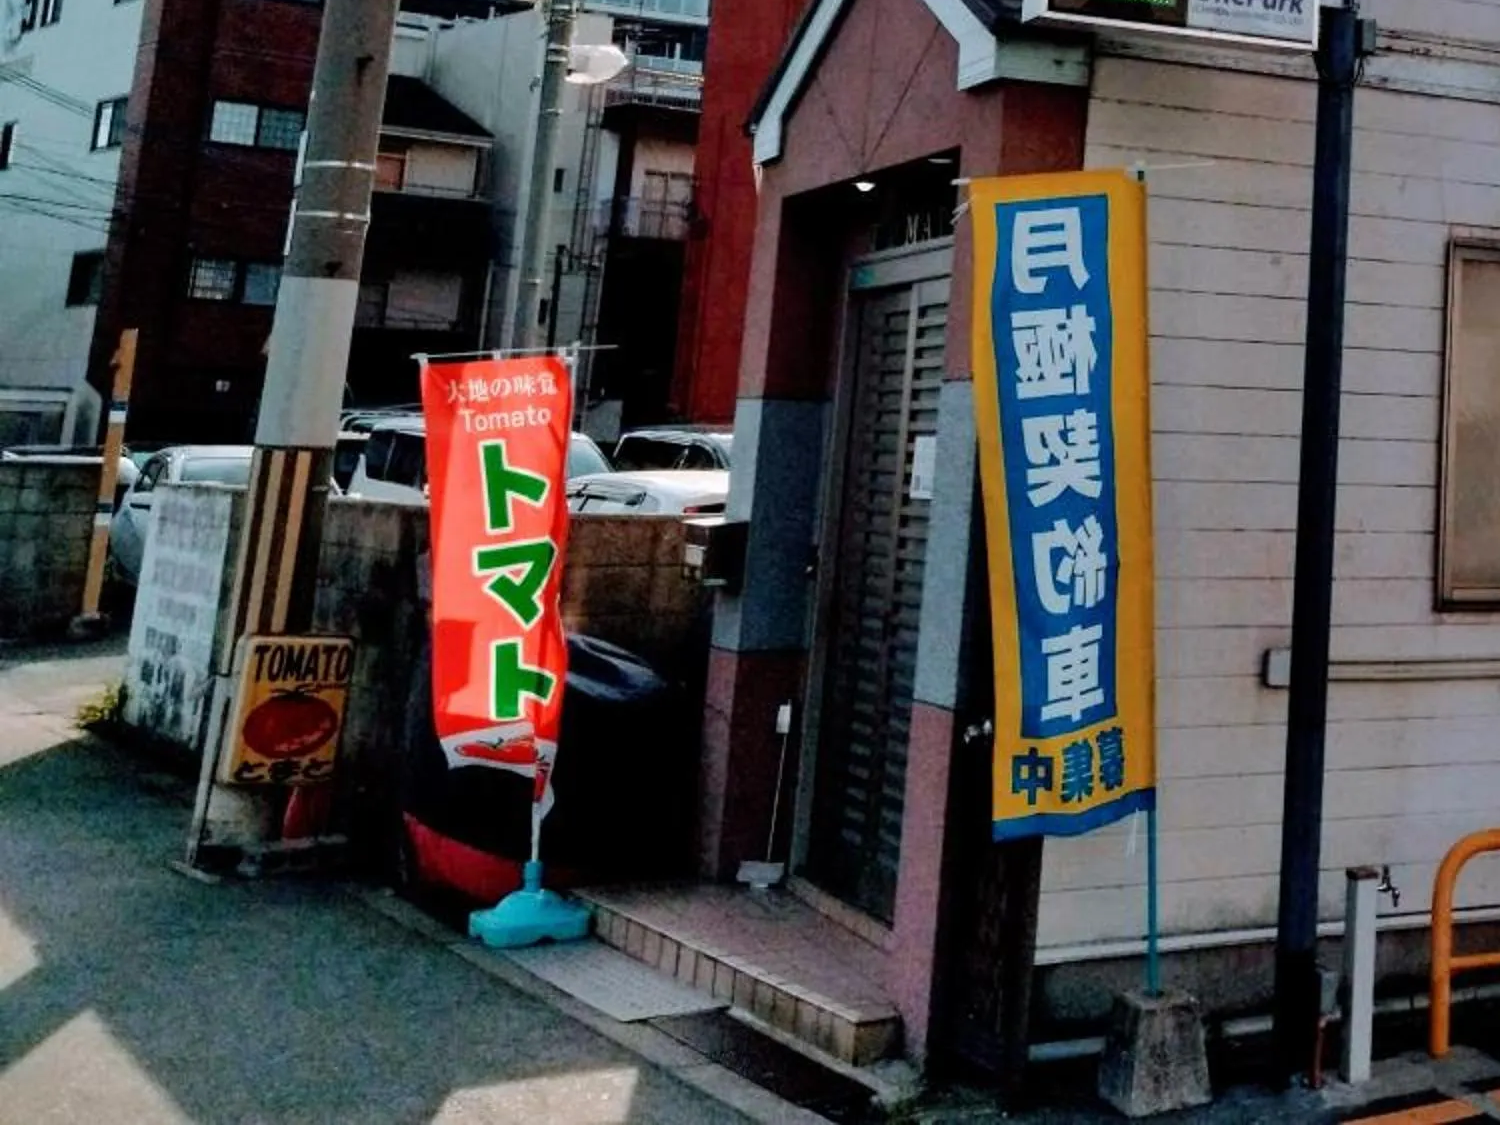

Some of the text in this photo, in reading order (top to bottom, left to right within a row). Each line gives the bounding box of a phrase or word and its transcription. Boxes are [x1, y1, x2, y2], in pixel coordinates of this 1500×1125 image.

[457, 405, 552, 432] Tomato
[472, 438, 559, 721] トマト
[254, 644, 351, 683] TOMATO
